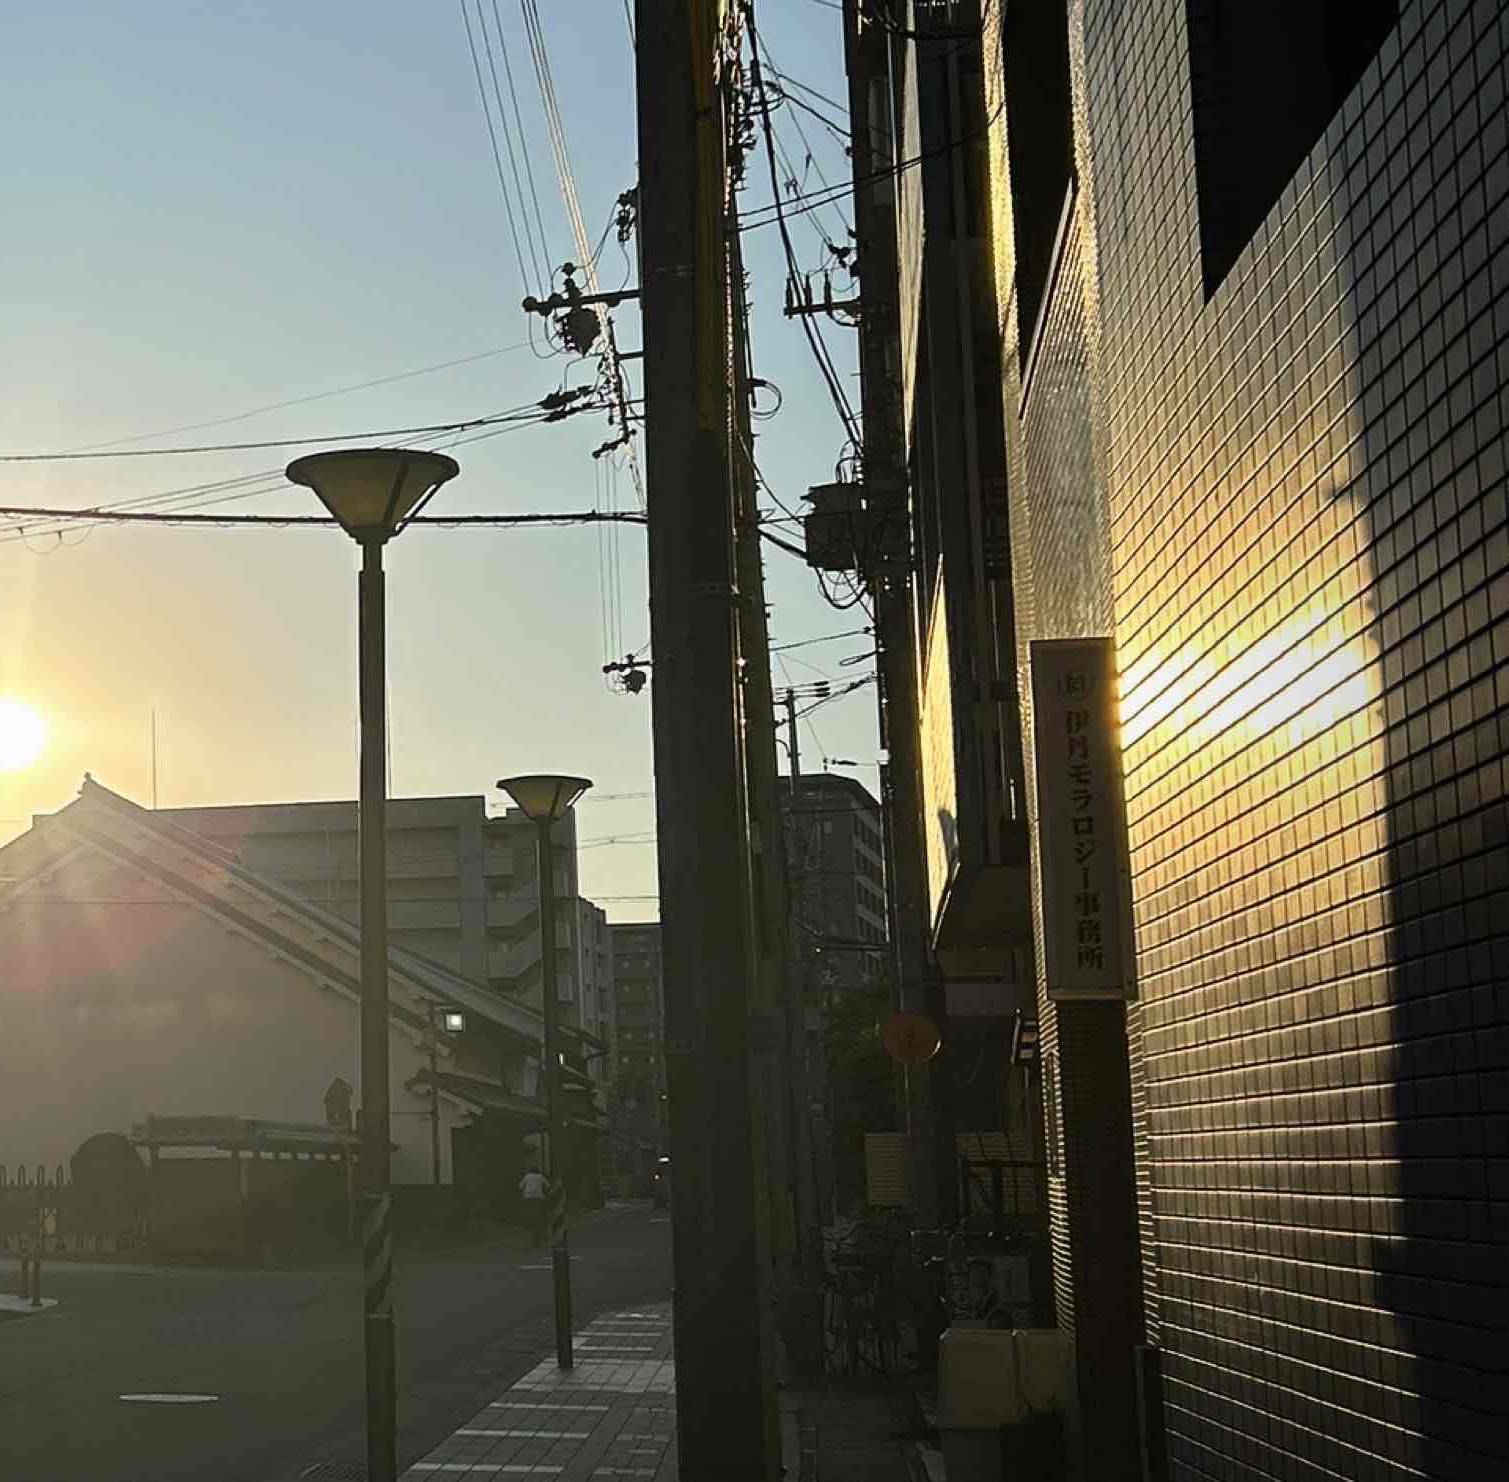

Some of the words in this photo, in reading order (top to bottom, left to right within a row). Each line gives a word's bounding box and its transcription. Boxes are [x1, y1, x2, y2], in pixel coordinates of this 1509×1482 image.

[1066, 709, 1103, 970] 伊丹モラロジー事務所
